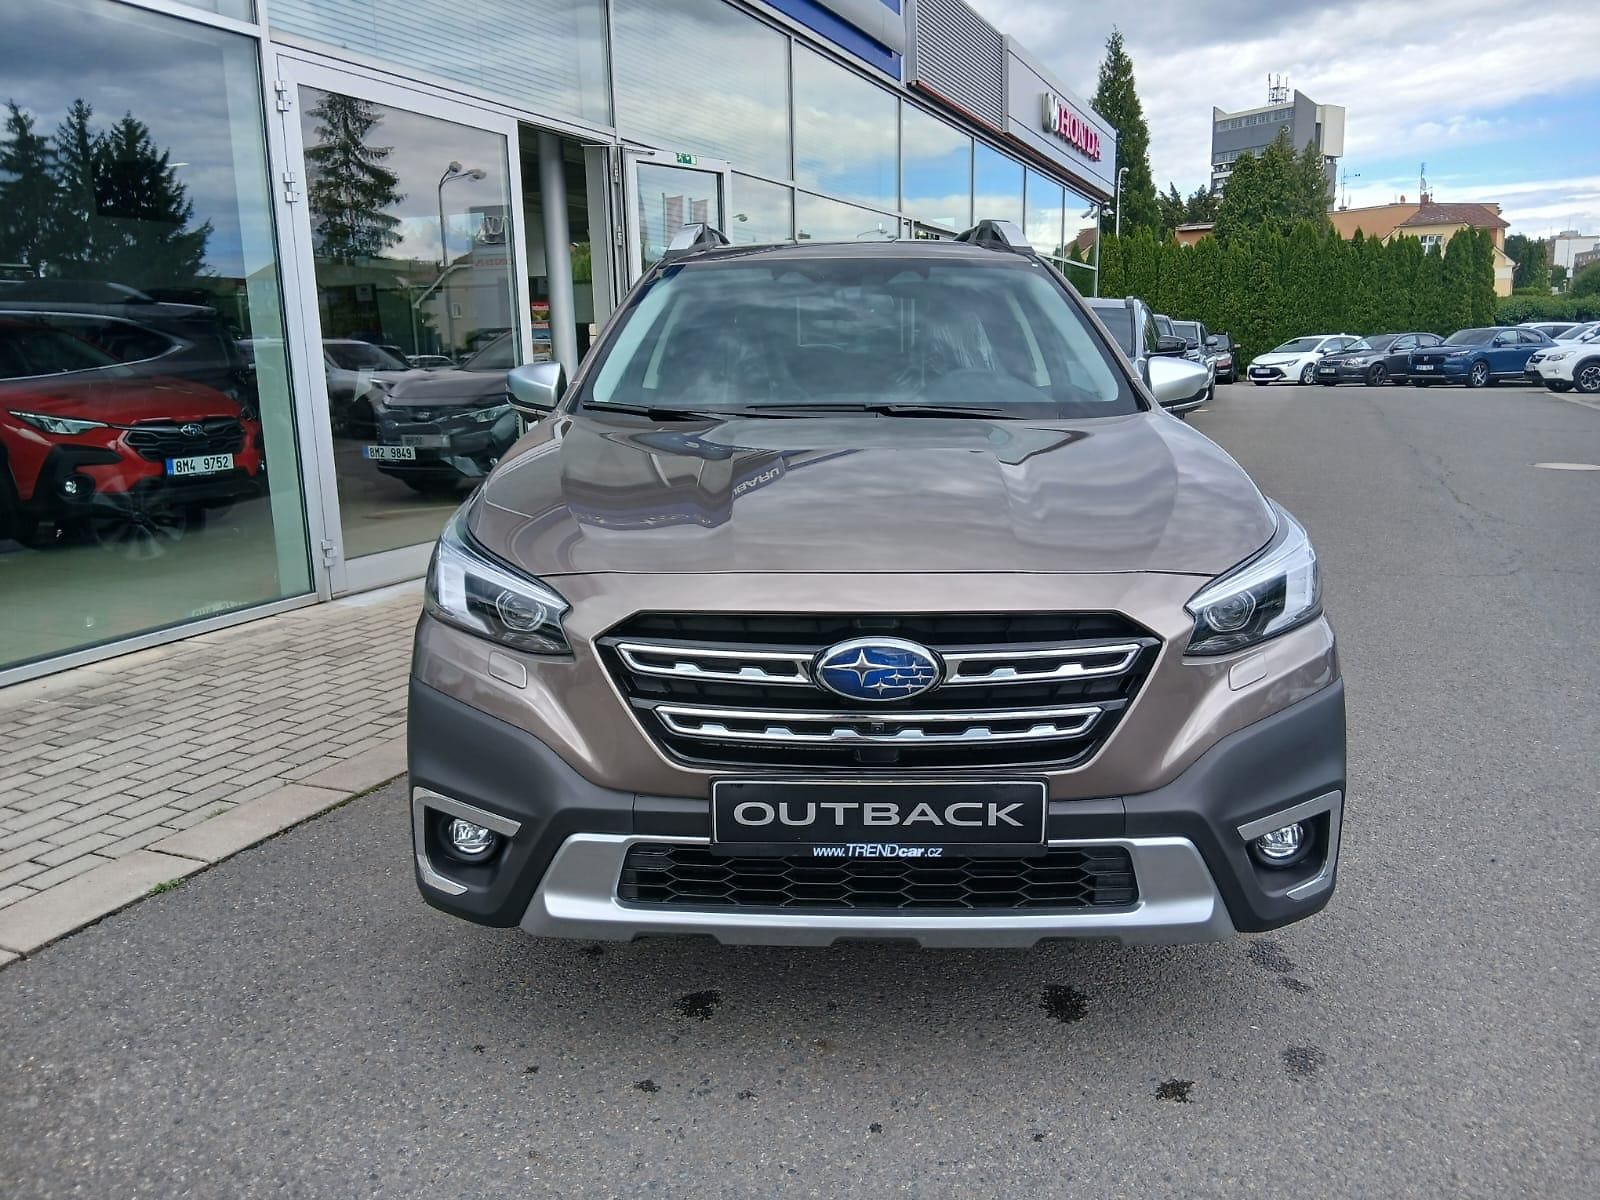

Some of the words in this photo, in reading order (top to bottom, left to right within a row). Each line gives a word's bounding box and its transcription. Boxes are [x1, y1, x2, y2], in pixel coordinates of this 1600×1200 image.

[1059, 105, 1101, 160] HONDA
[391, 447, 412, 458] 9849
[175, 460, 196, 473] 8M4
[203, 456, 229, 470] 9752
[733, 802, 1024, 827] OUTBACK
[813, 843, 943, 857] www.TRENDcar.cz
